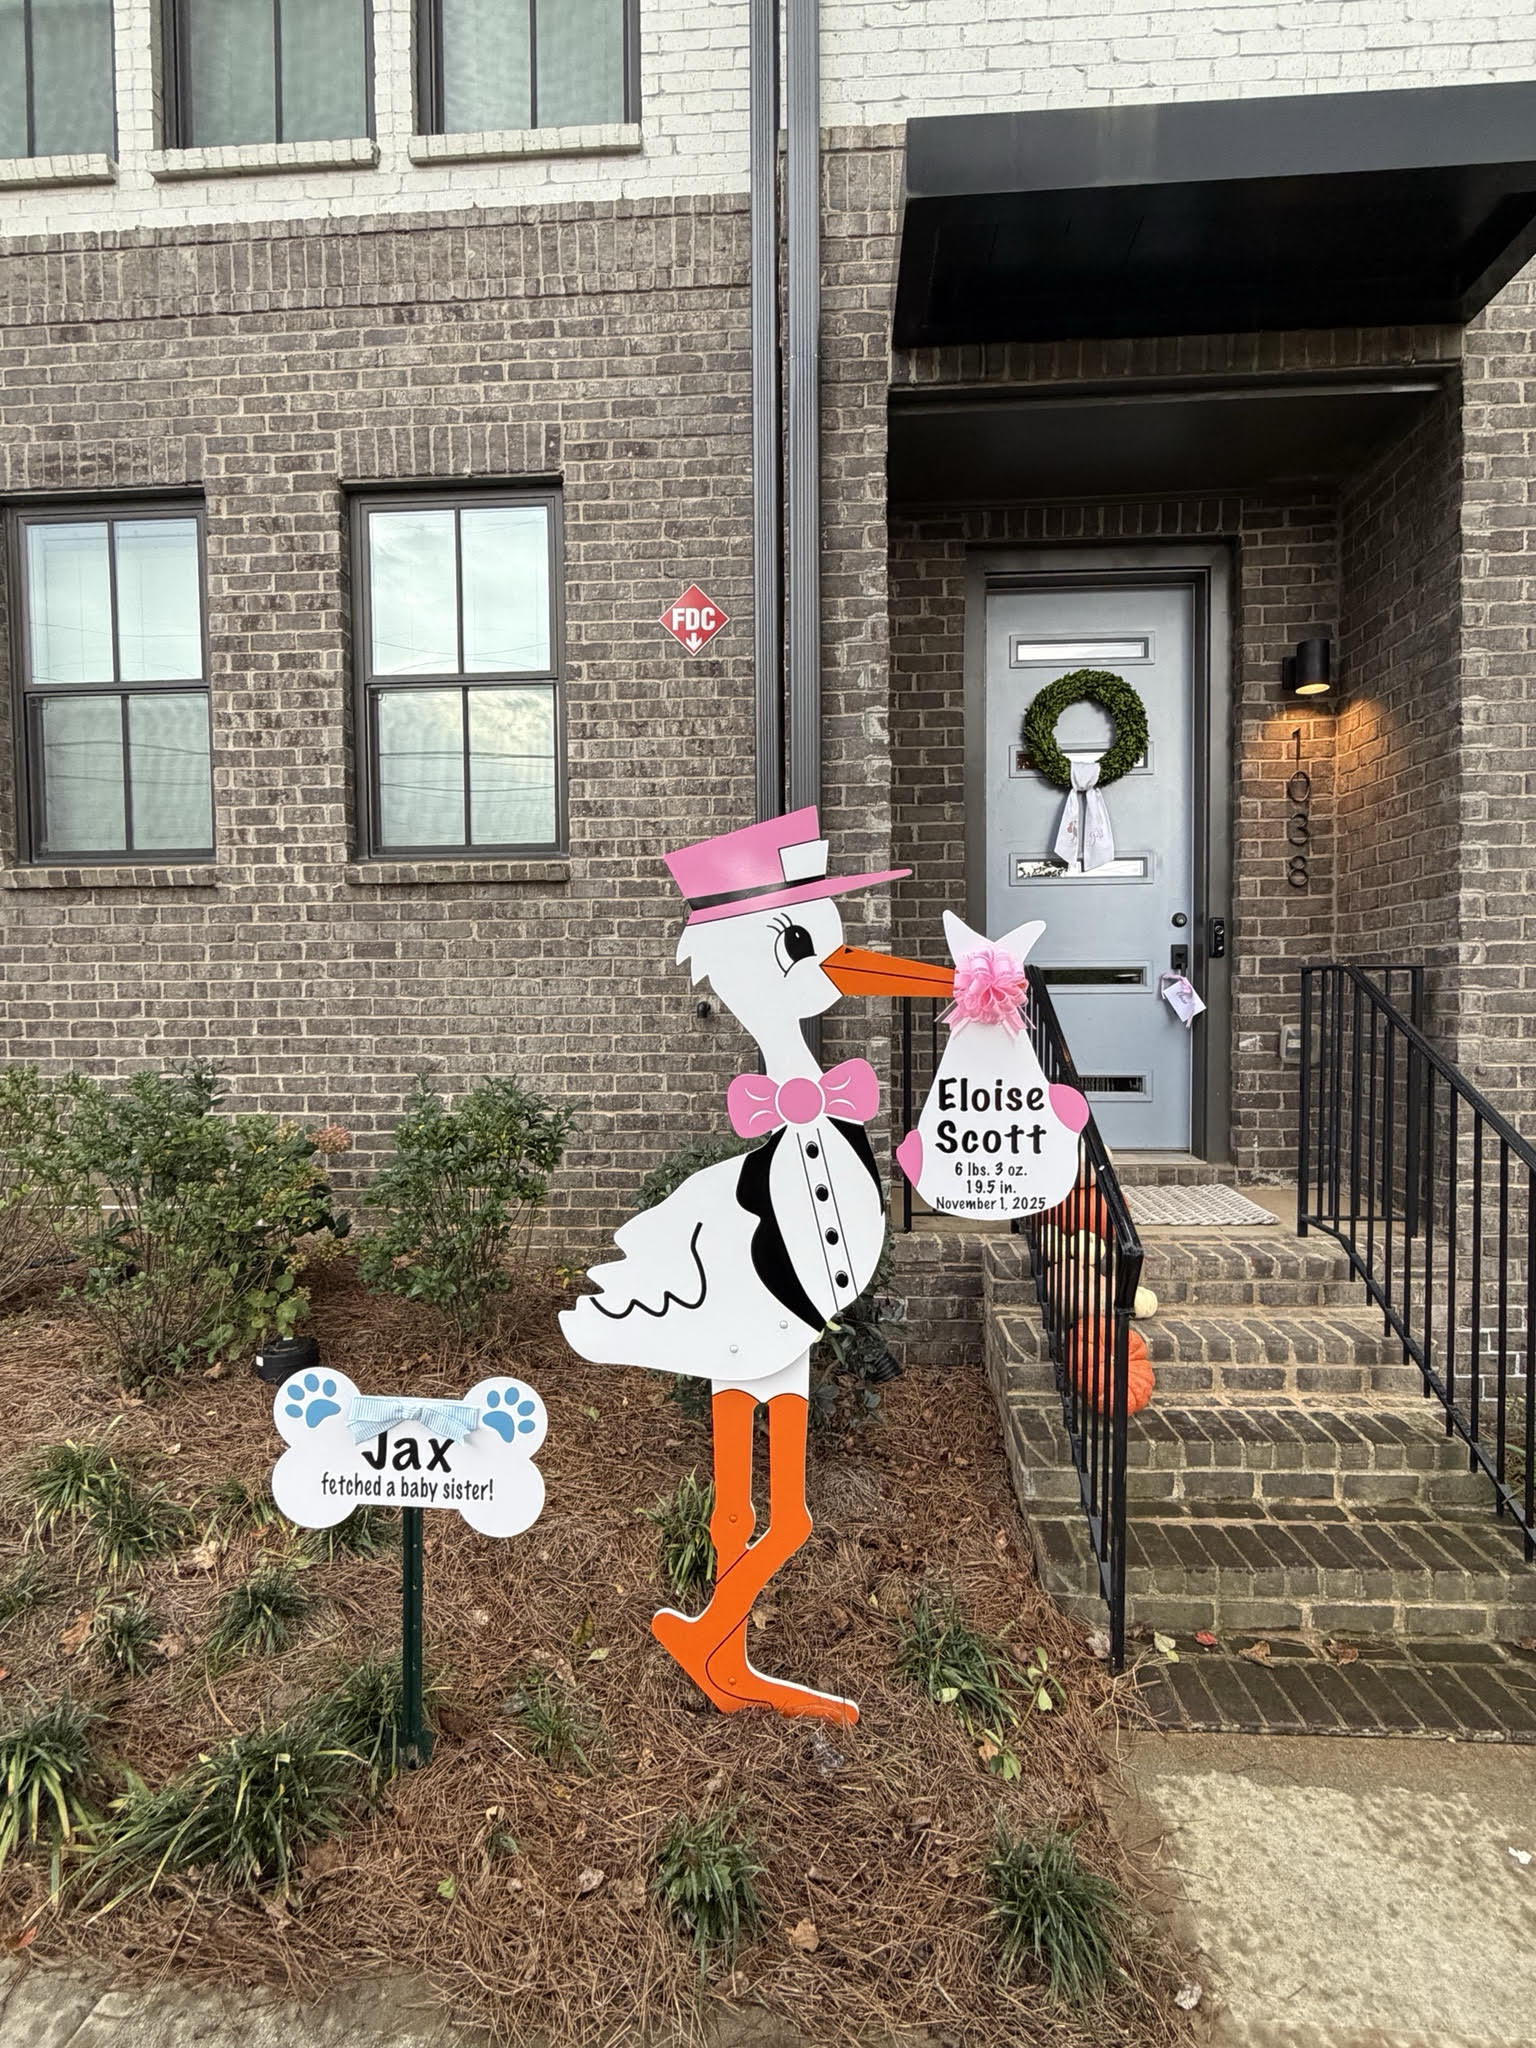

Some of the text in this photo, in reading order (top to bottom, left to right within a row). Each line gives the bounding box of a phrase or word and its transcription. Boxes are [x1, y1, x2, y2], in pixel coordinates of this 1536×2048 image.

[672, 606, 716, 631] FDC
[1288, 727, 1311, 888] 1038
[938, 1077, 1045, 1112] Eloise
[935, 1119, 1047, 1154] Scott
[954, 1162, 1028, 1176] 6 lbs. 3 oz.
[966, 1180, 1017, 1194] 19.5 in.
[936, 1197, 1046, 1211] November 1, 2025
[361, 1430, 455, 1473] Jax
[321, 1471, 494, 1502] fetched a baby sister!
